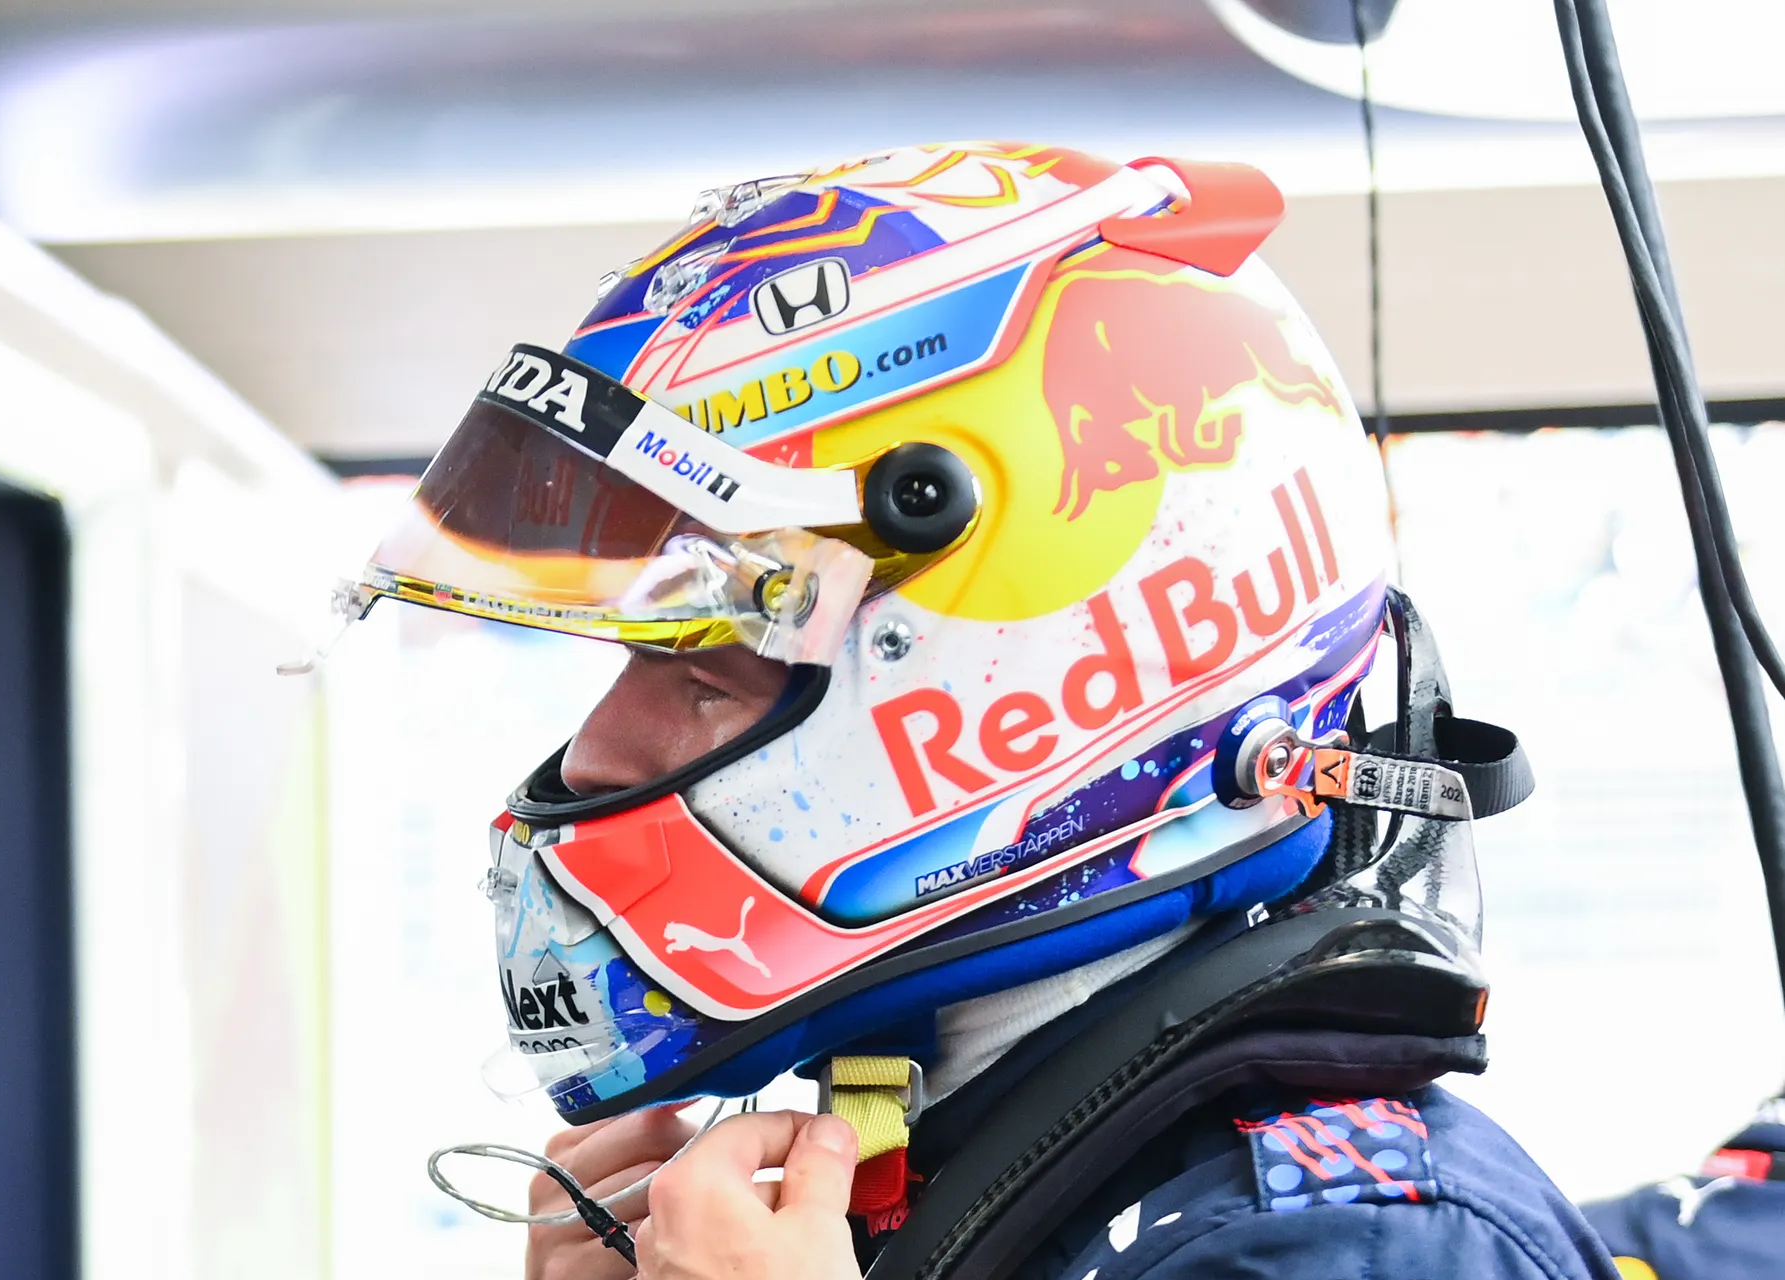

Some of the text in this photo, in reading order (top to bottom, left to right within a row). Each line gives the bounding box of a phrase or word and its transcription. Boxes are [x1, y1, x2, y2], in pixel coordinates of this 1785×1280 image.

[636, 431, 713, 487] Mobil
[870, 466, 1339, 818] Red Bull
[1358, 766, 1378, 798] FIA
